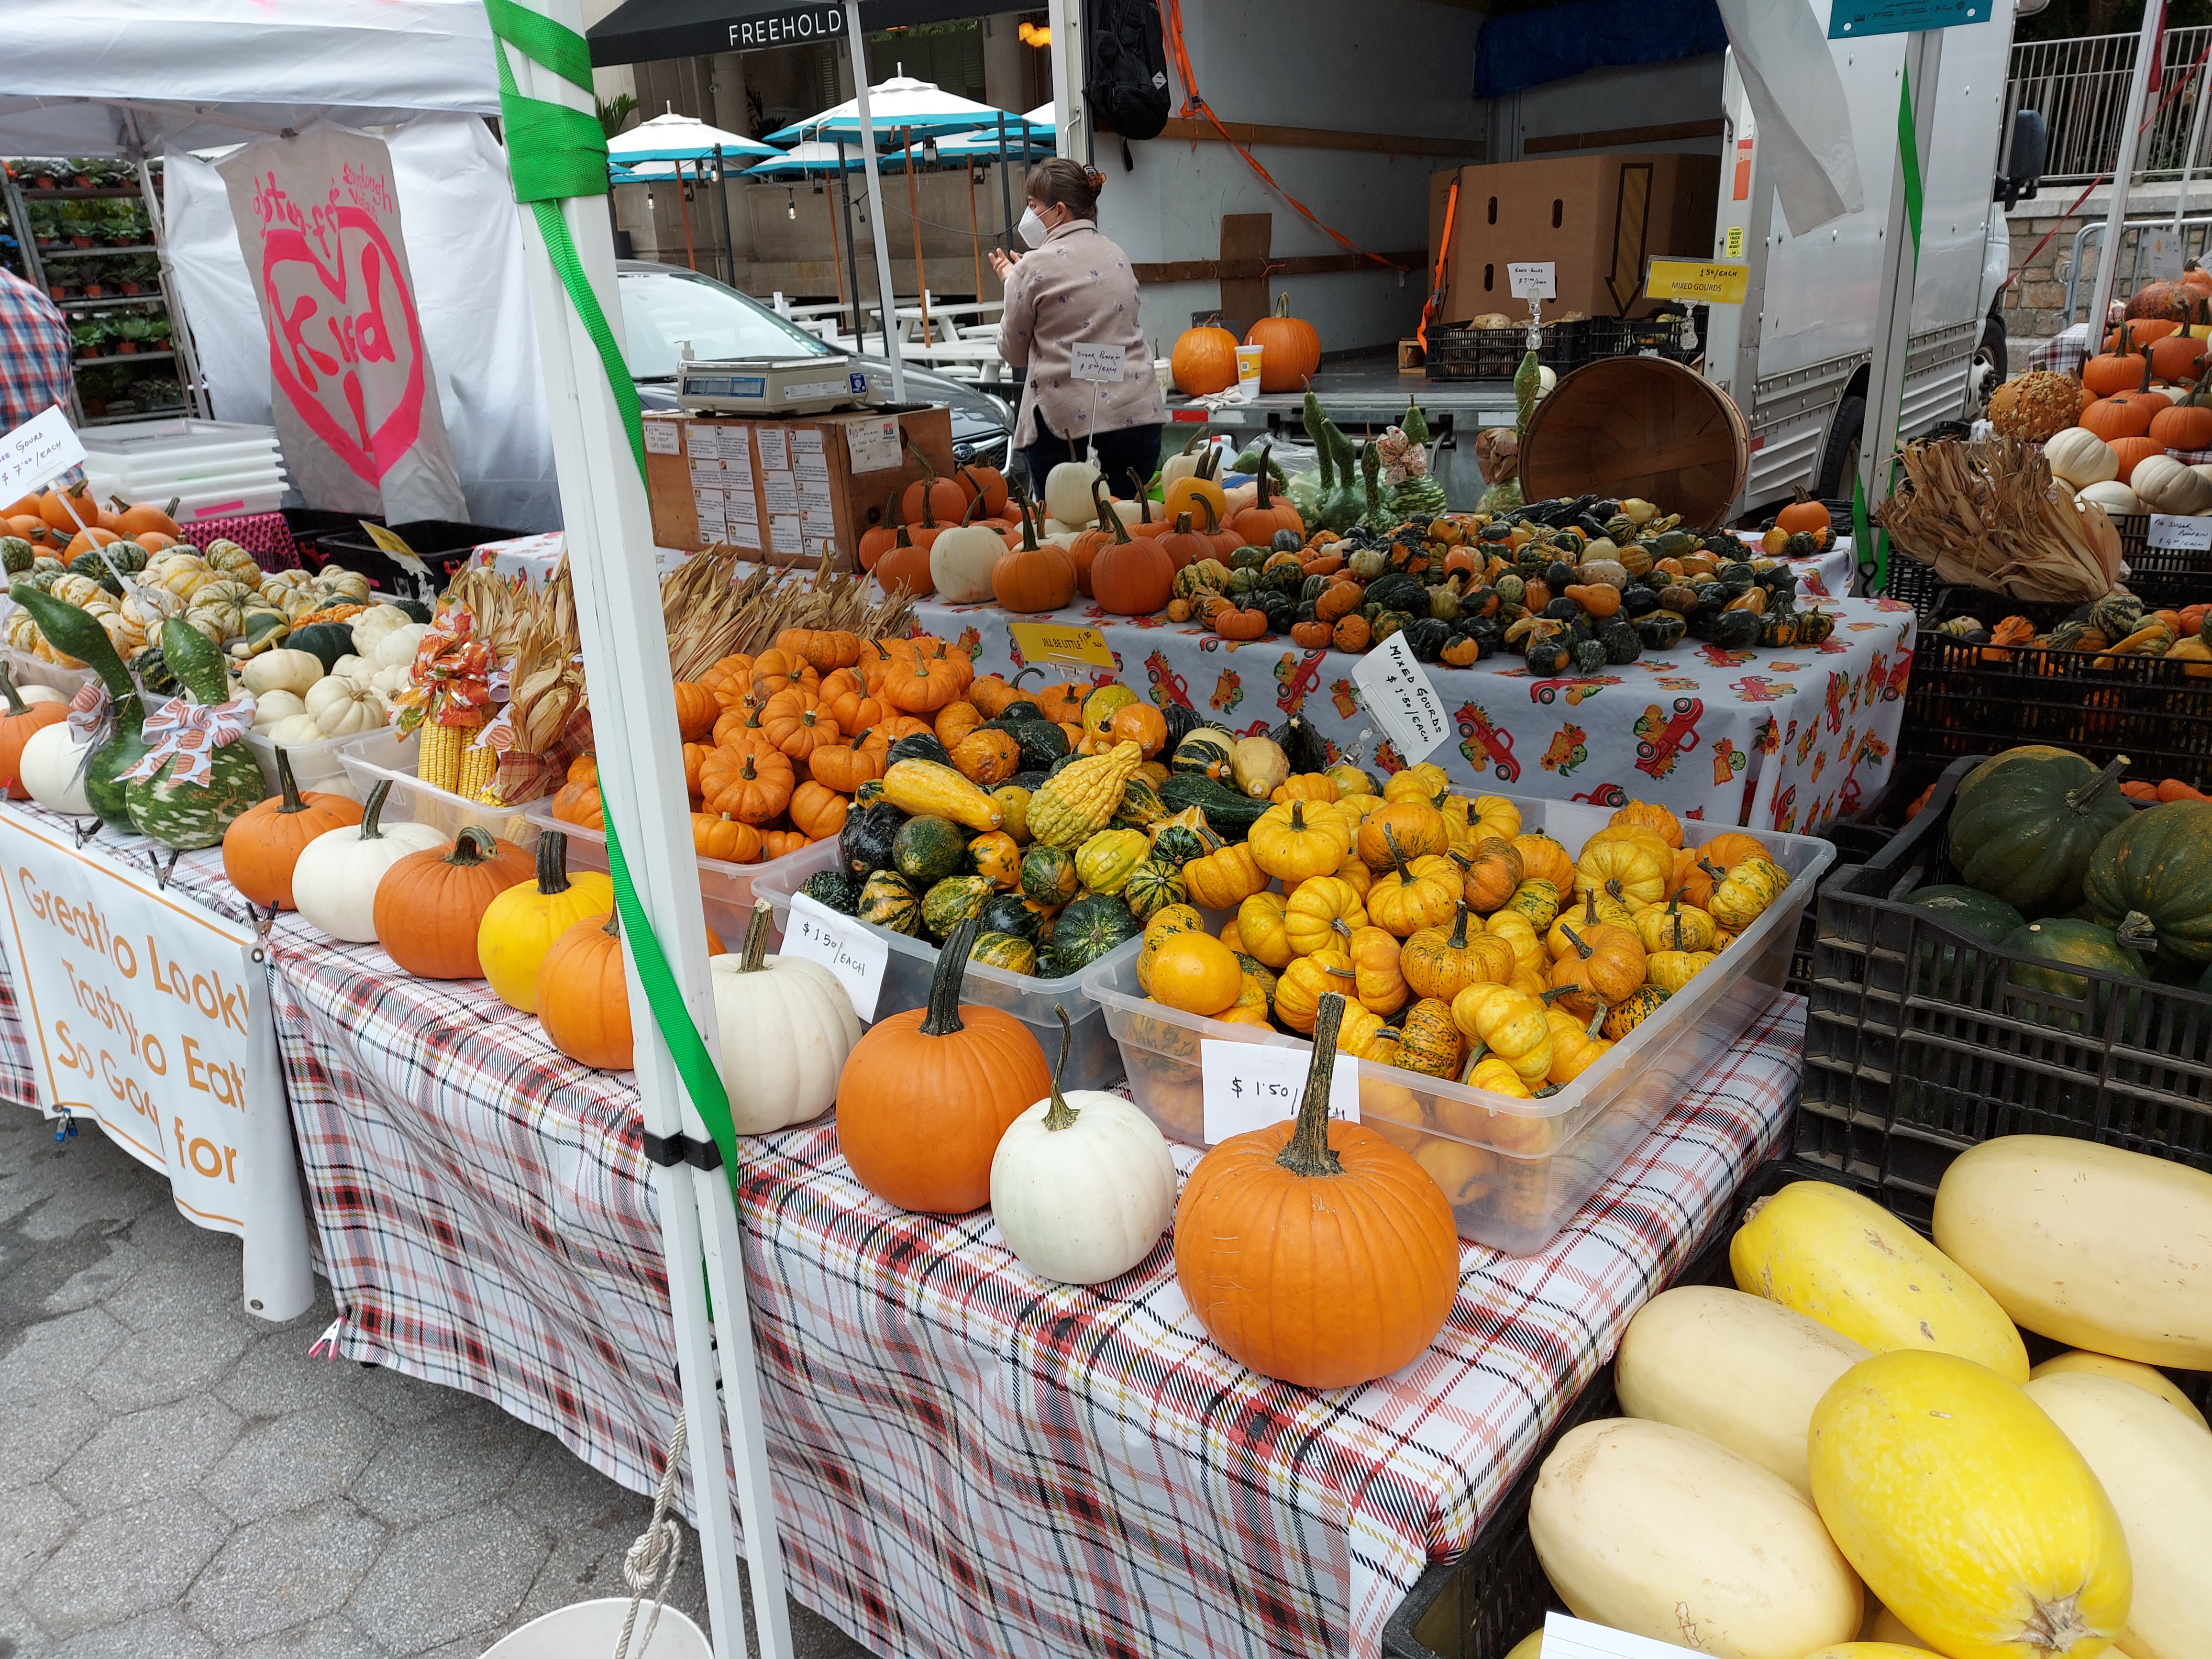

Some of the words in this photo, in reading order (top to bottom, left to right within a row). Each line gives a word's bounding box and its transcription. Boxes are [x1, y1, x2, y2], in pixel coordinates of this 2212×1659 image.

[729, 10, 841, 46] FREEHOLD
[1671, 282, 1692, 290] MIXED
[1693, 283, 1721, 292] GOURDS
[16, 432, 43, 454] GOURD
[1042, 638, 1054, 647] JILL
[1053, 639, 1062, 648] BE
[1062, 640, 1083, 650] LITTLE
[1386, 675, 1397, 683] $
[1390, 645, 1415, 683] MIXED
[1416, 688, 1442, 733] GOURDS
[19, 866, 105, 954] Great
[100, 912, 137, 979] to
[802, 921, 809, 937] $
[61, 958, 136, 1055] Tasty
[1231, 1076, 1243, 1099] $
[55, 1020, 95, 1080] So
[174, 1116, 237, 1185] for
